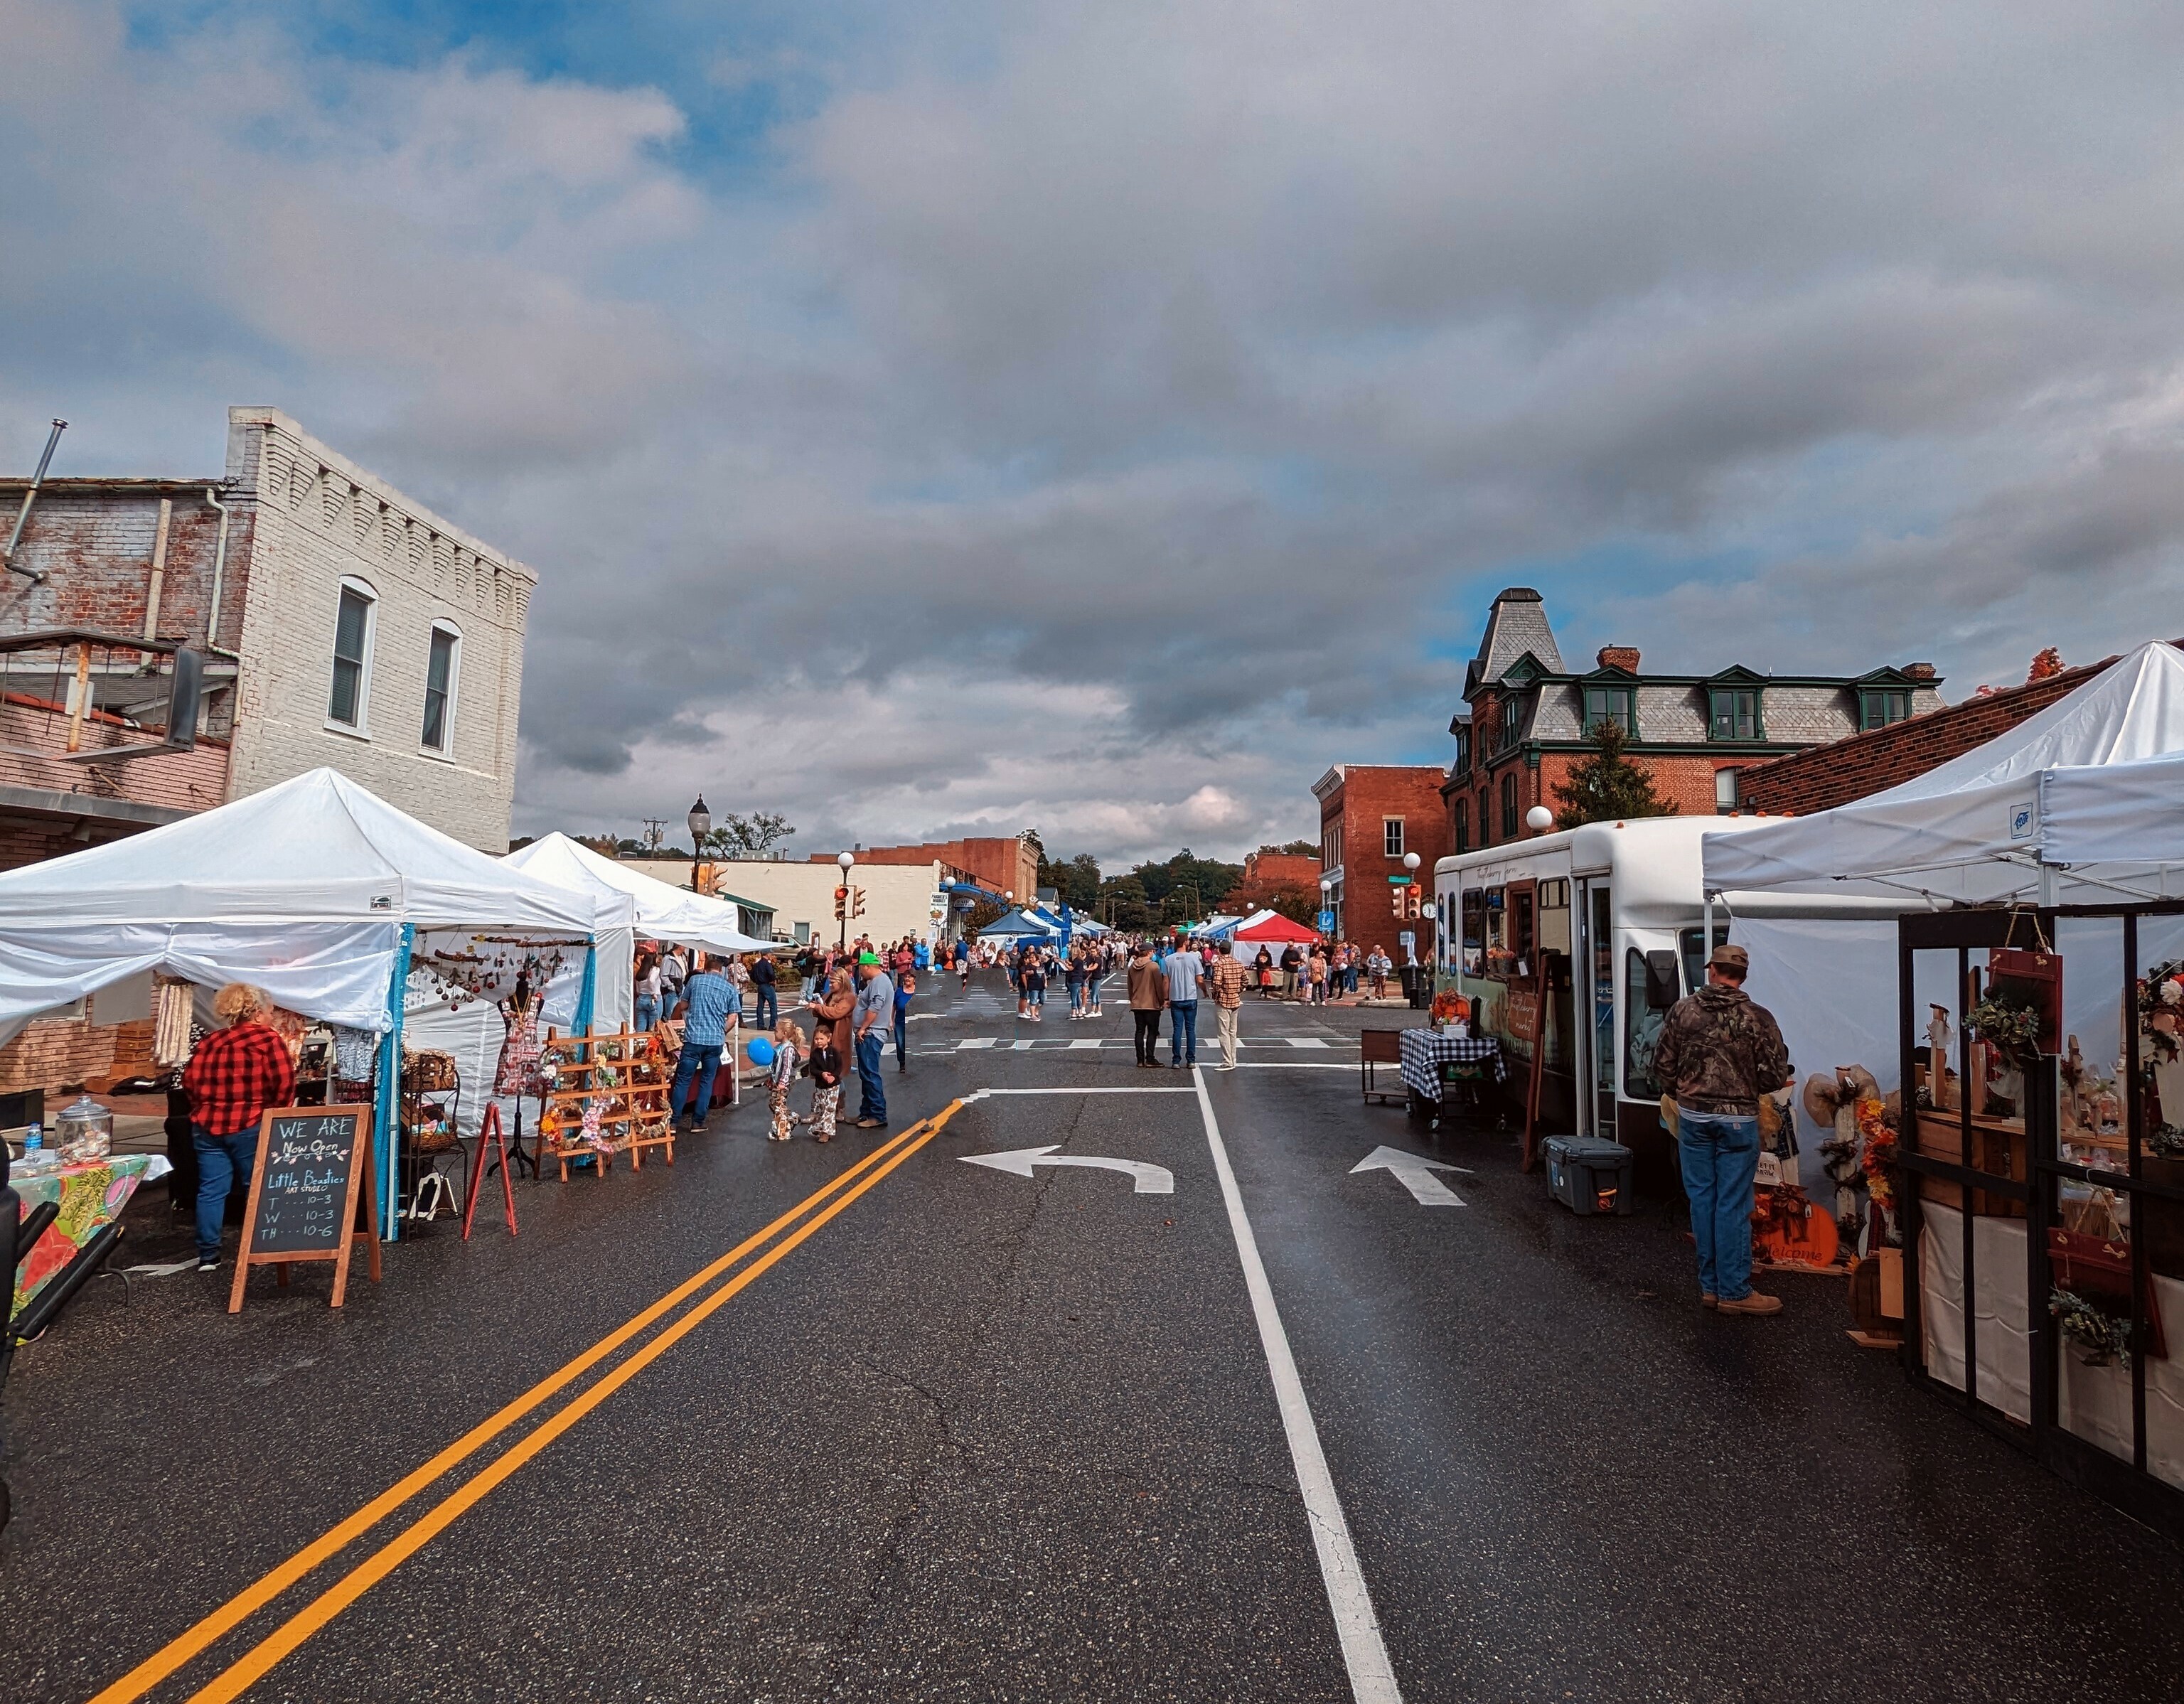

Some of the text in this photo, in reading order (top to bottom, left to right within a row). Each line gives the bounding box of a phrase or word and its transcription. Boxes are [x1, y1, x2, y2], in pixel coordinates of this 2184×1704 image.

[279, 1118, 353, 1139] WE ARE
[268, 1169, 345, 1189] Little Beasties
[268, 1194, 332, 1209] T 10-3
[265, 1209, 334, 1223] W 10-3
[261, 1226, 333, 1241] TH 10-6
